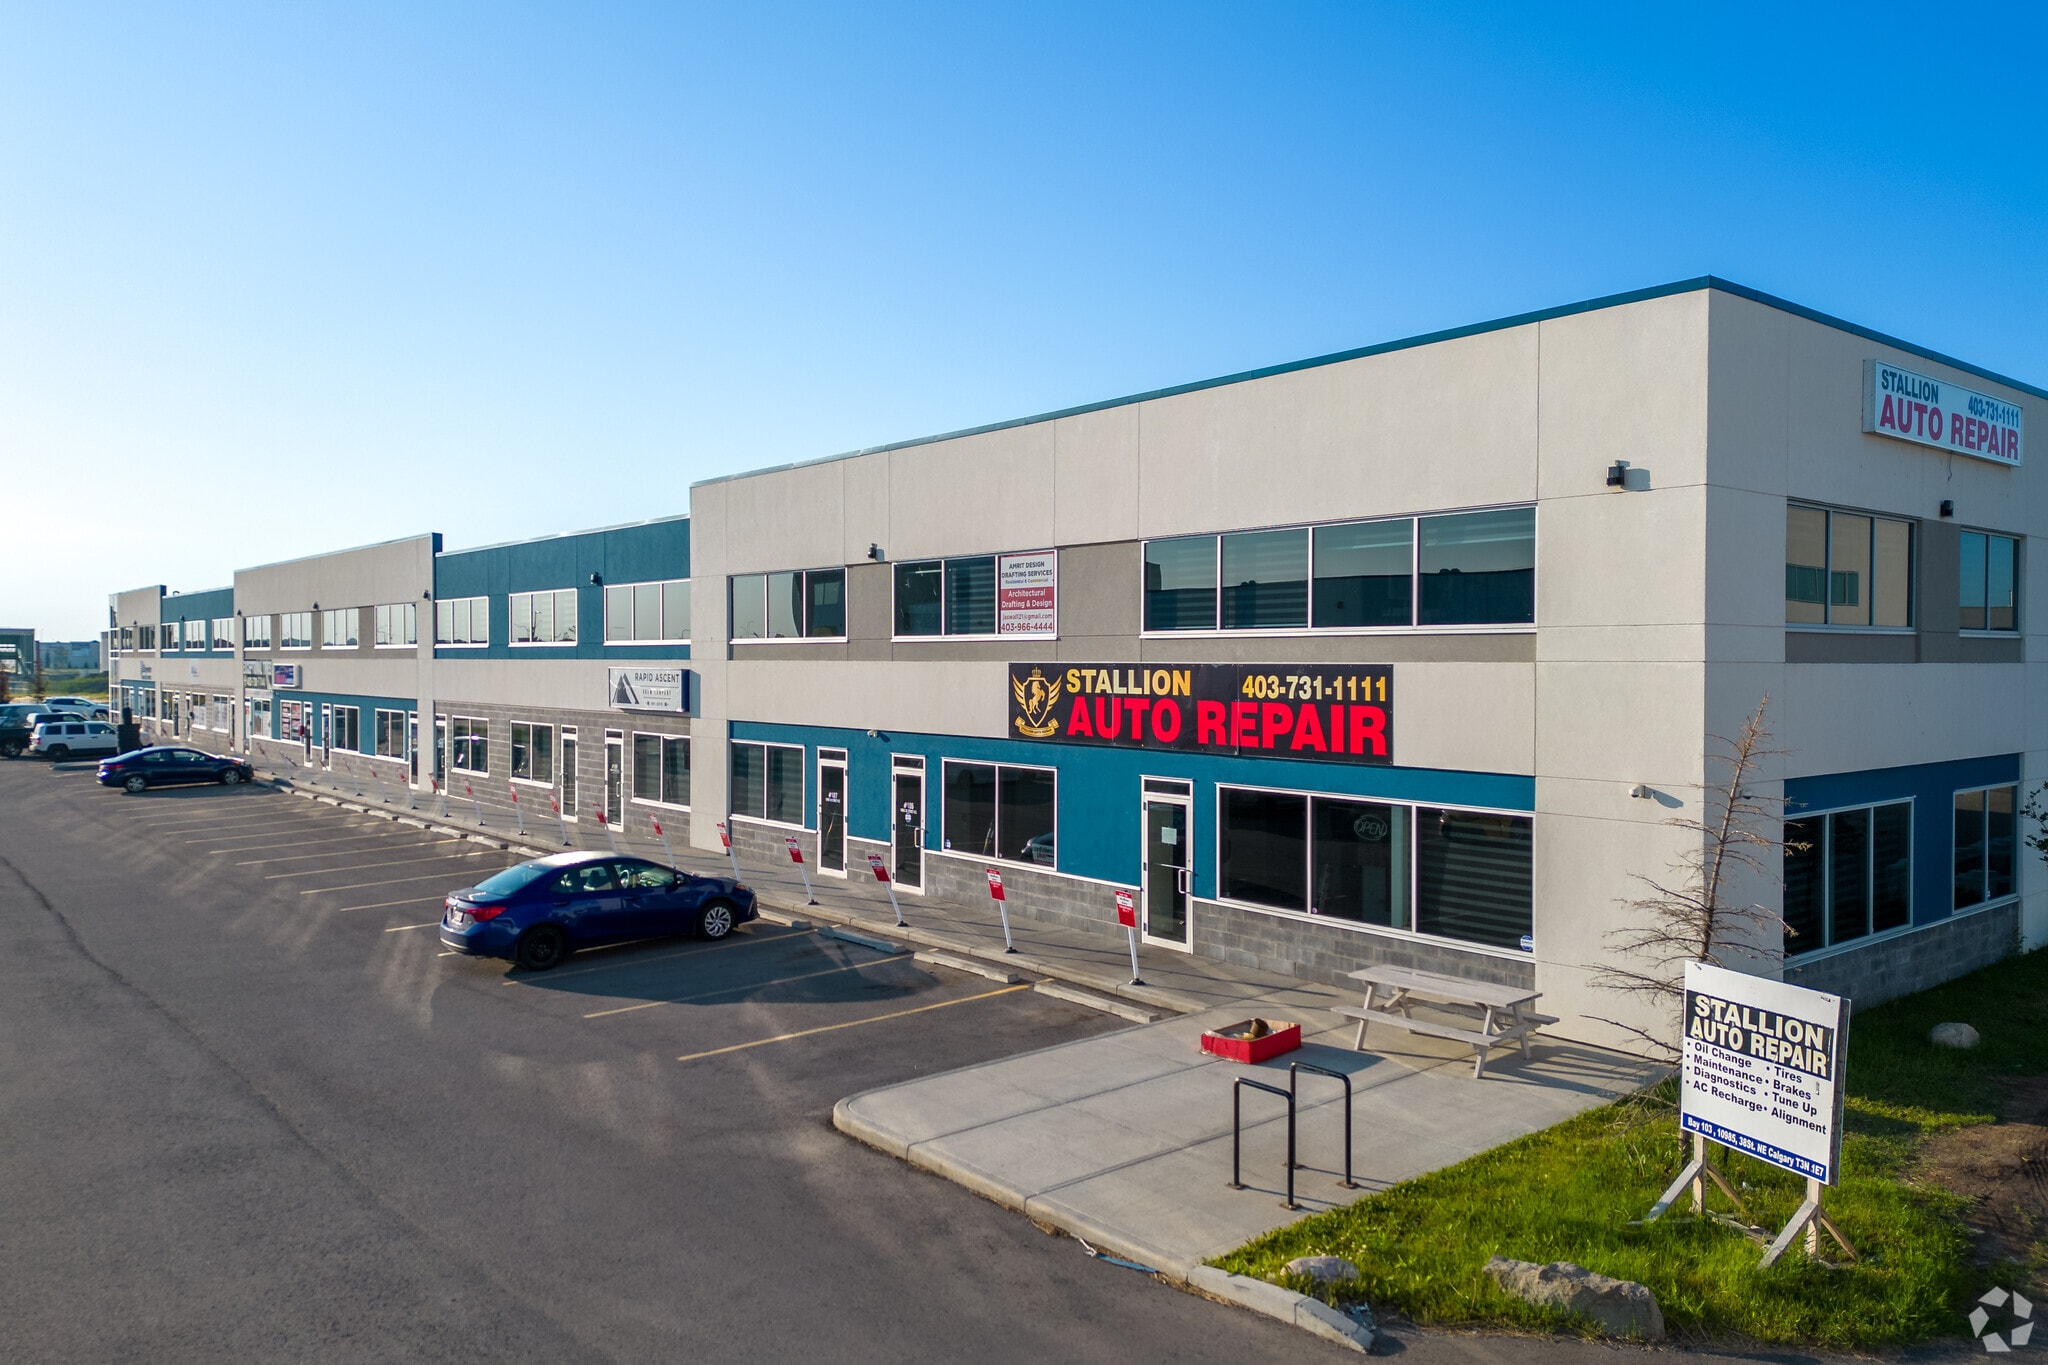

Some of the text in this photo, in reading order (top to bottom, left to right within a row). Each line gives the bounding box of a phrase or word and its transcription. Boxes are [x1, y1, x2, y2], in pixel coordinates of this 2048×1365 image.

[1881, 369, 1939, 404] STALLION
[1968, 395, 2019, 428] 403-731-1111
[1880, 394, 2019, 460] AUTO REPAIR
[1028, 569, 1053, 577] SERVICES
[1002, 601, 1025, 609] Drafting
[1031, 600, 1053, 608] Design
[1008, 589, 1046, 598] Architectural
[1000, 622, 1053, 632] 403-966-4444
[634, 672, 680, 683] RAPID ASCENT
[1066, 668, 1191, 696] STALLION
[1242, 675, 1386, 702] 403-731-1111
[1066, 696, 1388, 756] AUTO REPAIR
[1356, 820, 1384, 836] OPEN
[1694, 995, 1824, 1051] STALLION
[1690, 1016, 1828, 1077] AUTO REPAIR
[1694, 1043, 1752, 1068] Oil Change
[1693, 1055, 1763, 1084] Maintenance
[1694, 1066, 1757, 1095] Diagnostics
[1774, 1066, 1802, 1083] Tires
[1693, 1079, 1763, 1112] AC Recharge
[1772, 1091, 1817, 1116] Tune Up
[1773, 1080, 1812, 1100] Brakes
[1771, 1107, 1827, 1135] Alignment
[1687, 1117, 1700, 1131] Bay
[1757, 1144, 1767, 1154] NE
[1768, 1147, 1794, 1167] Calgary
[1795, 1157, 1810, 1171] T3N
